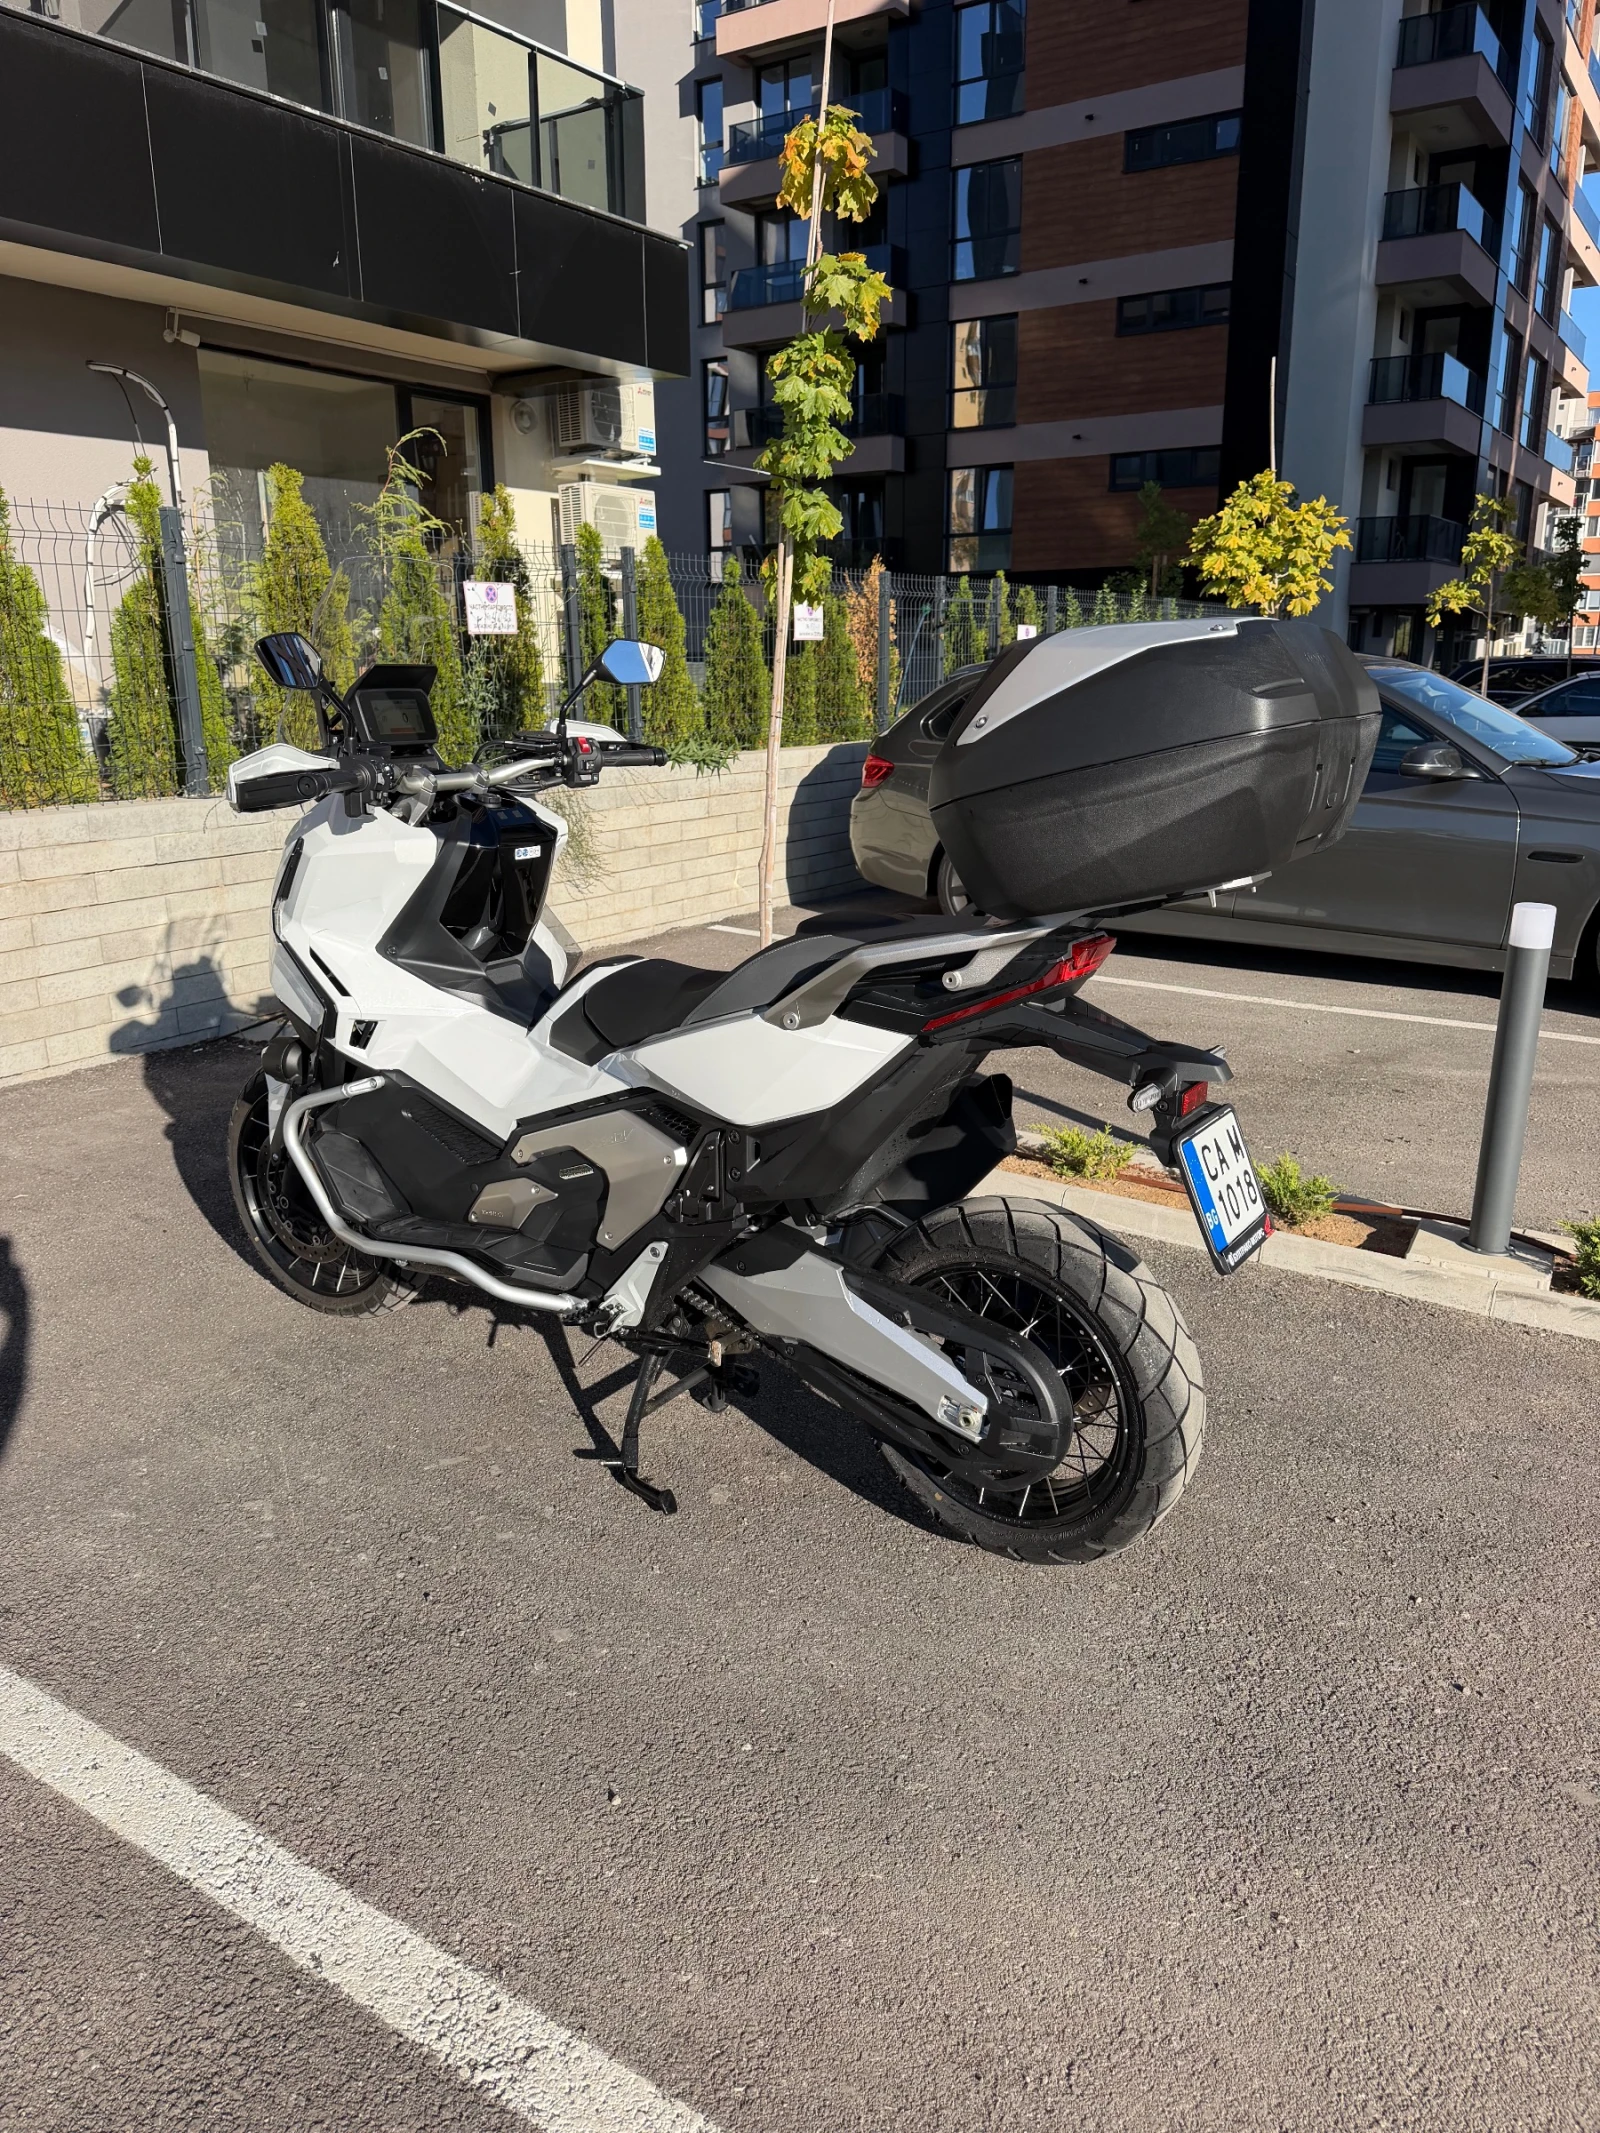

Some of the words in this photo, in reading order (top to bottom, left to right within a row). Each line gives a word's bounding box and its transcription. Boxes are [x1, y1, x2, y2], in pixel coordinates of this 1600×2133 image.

[1201, 1138, 1230, 1181] CA
[1226, 1125, 1245, 1163] M
[1205, 1208, 1219, 1230] BG
[1218, 1169, 1257, 1226] 1018
